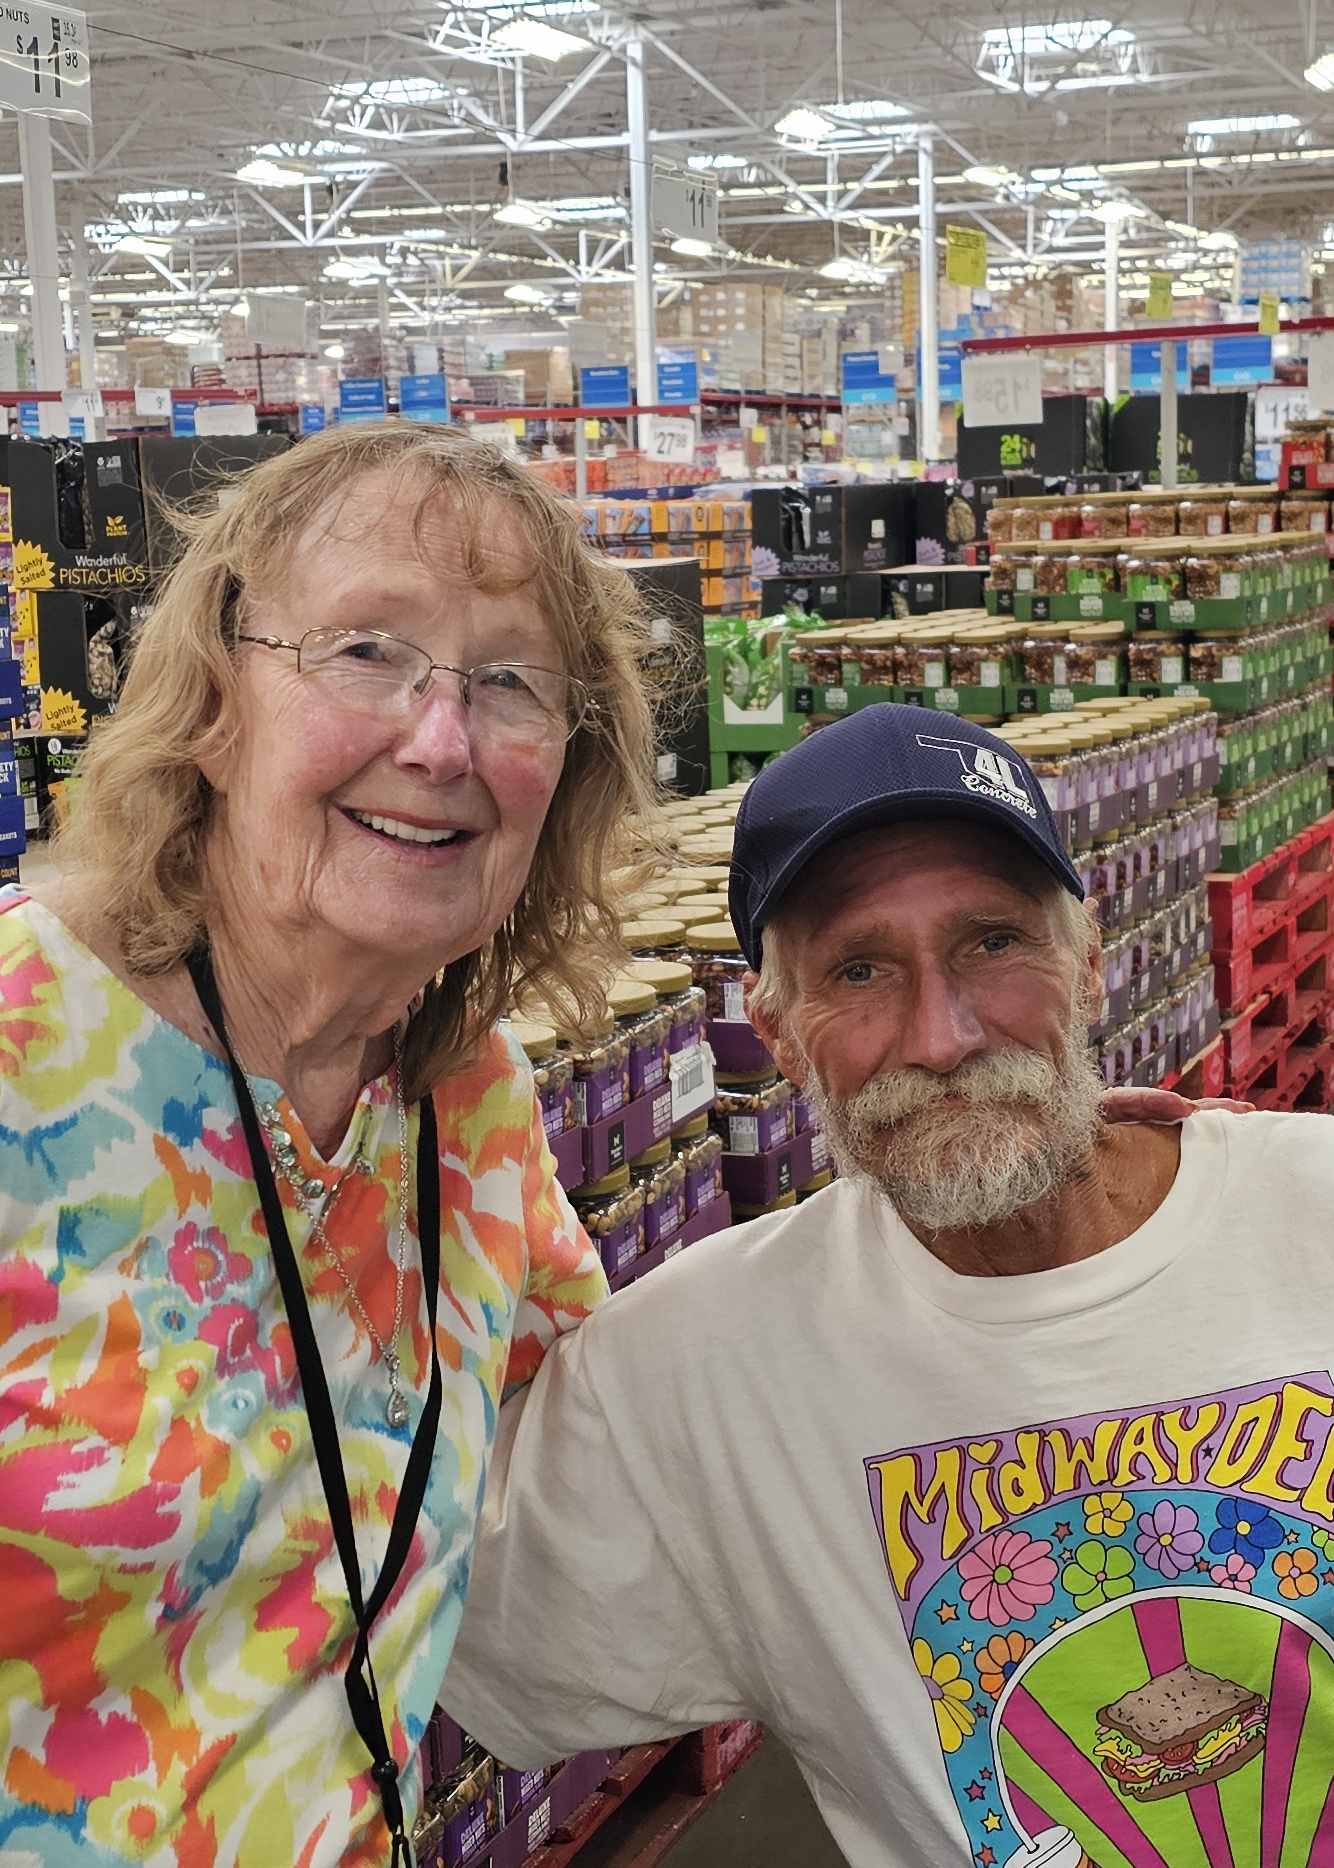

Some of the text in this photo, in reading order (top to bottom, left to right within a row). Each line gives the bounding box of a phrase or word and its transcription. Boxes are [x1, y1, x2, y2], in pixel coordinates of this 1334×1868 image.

[5, 8, 30, 25] NUTS
[105, 523, 127, 533] PLANT
[15, 556, 44, 574] Lightly
[75, 552, 127, 568] Wonderful
[781, 561, 840, 574] PISTACHIOS
[19, 568, 46, 585] Salted
[59, 565, 146, 586] PISTACHIOS
[45, 704, 75, 721] Lightly
[50, 715, 78, 731] Salted
[973, 748, 1029, 800] 4L
[960, 775, 1037, 820] Concrete
[528, 1796, 551, 1827] DELUXE
[460, 1811, 484, 1845] DELUXE
